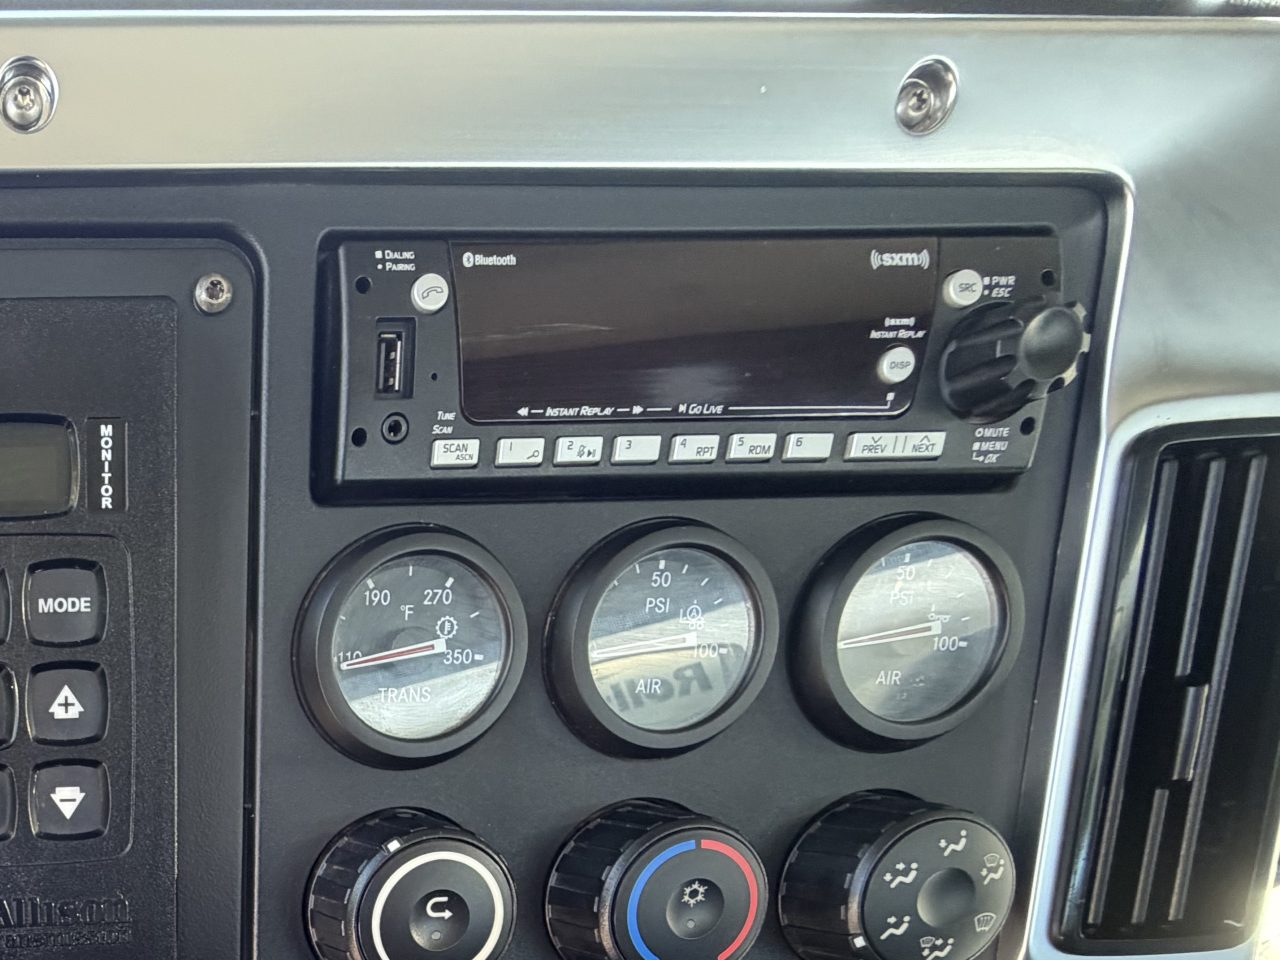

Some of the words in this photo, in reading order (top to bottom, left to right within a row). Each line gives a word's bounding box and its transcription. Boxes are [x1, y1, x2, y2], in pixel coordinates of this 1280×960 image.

[385, 250, 415, 260] DIALING
[474, 253, 517, 266] Bluetooth
[385, 262, 416, 271] PAIRING
[991, 275, 1016, 285] PWR
[958, 282, 978, 293] SRC
[991, 287, 1013, 297] ESC
[889, 360, 912, 370] DISP
[437, 410, 457, 420] TUNE
[545, 406, 580, 417] INSTANT
[580, 405, 615, 416] REPLAY
[432, 424, 454, 434] SCAN
[983, 427, 1011, 438] MUTE
[566, 440, 574, 451] 2
[625, 439, 632, 449] 3
[680, 438, 687, 448] 4
[737, 437, 745, 446] 5
[795, 437, 803, 447] 6
[980, 440, 1008, 451] MENU
[442, 443, 469, 453] SCAN
[695, 446, 715, 457] RPT
[748, 444, 771, 455] RDM
[861, 444, 887, 454] PREV
[911, 442, 937, 453] NEXT
[455, 453, 474, 461] ASCN
[99, 424, 114, 510] MONITOR
[895, 566, 916, 581] 50
[650, 571, 672, 588] 50
[364, 589, 391, 606] 190
[423, 588, 453, 605] 270
[889, 590, 915, 606] PSI
[38, 597, 91, 613] MODE
[645, 597, 671, 614] PSI
[400, 604, 415, 621] °F
[932, 635, 959, 651] 100
[693, 644, 719, 658] 100
[443, 649, 473, 665] 350
[875, 670, 903, 685] AIR
[635, 678, 662, 694] AIR
[377, 686, 432, 703] TRANS
